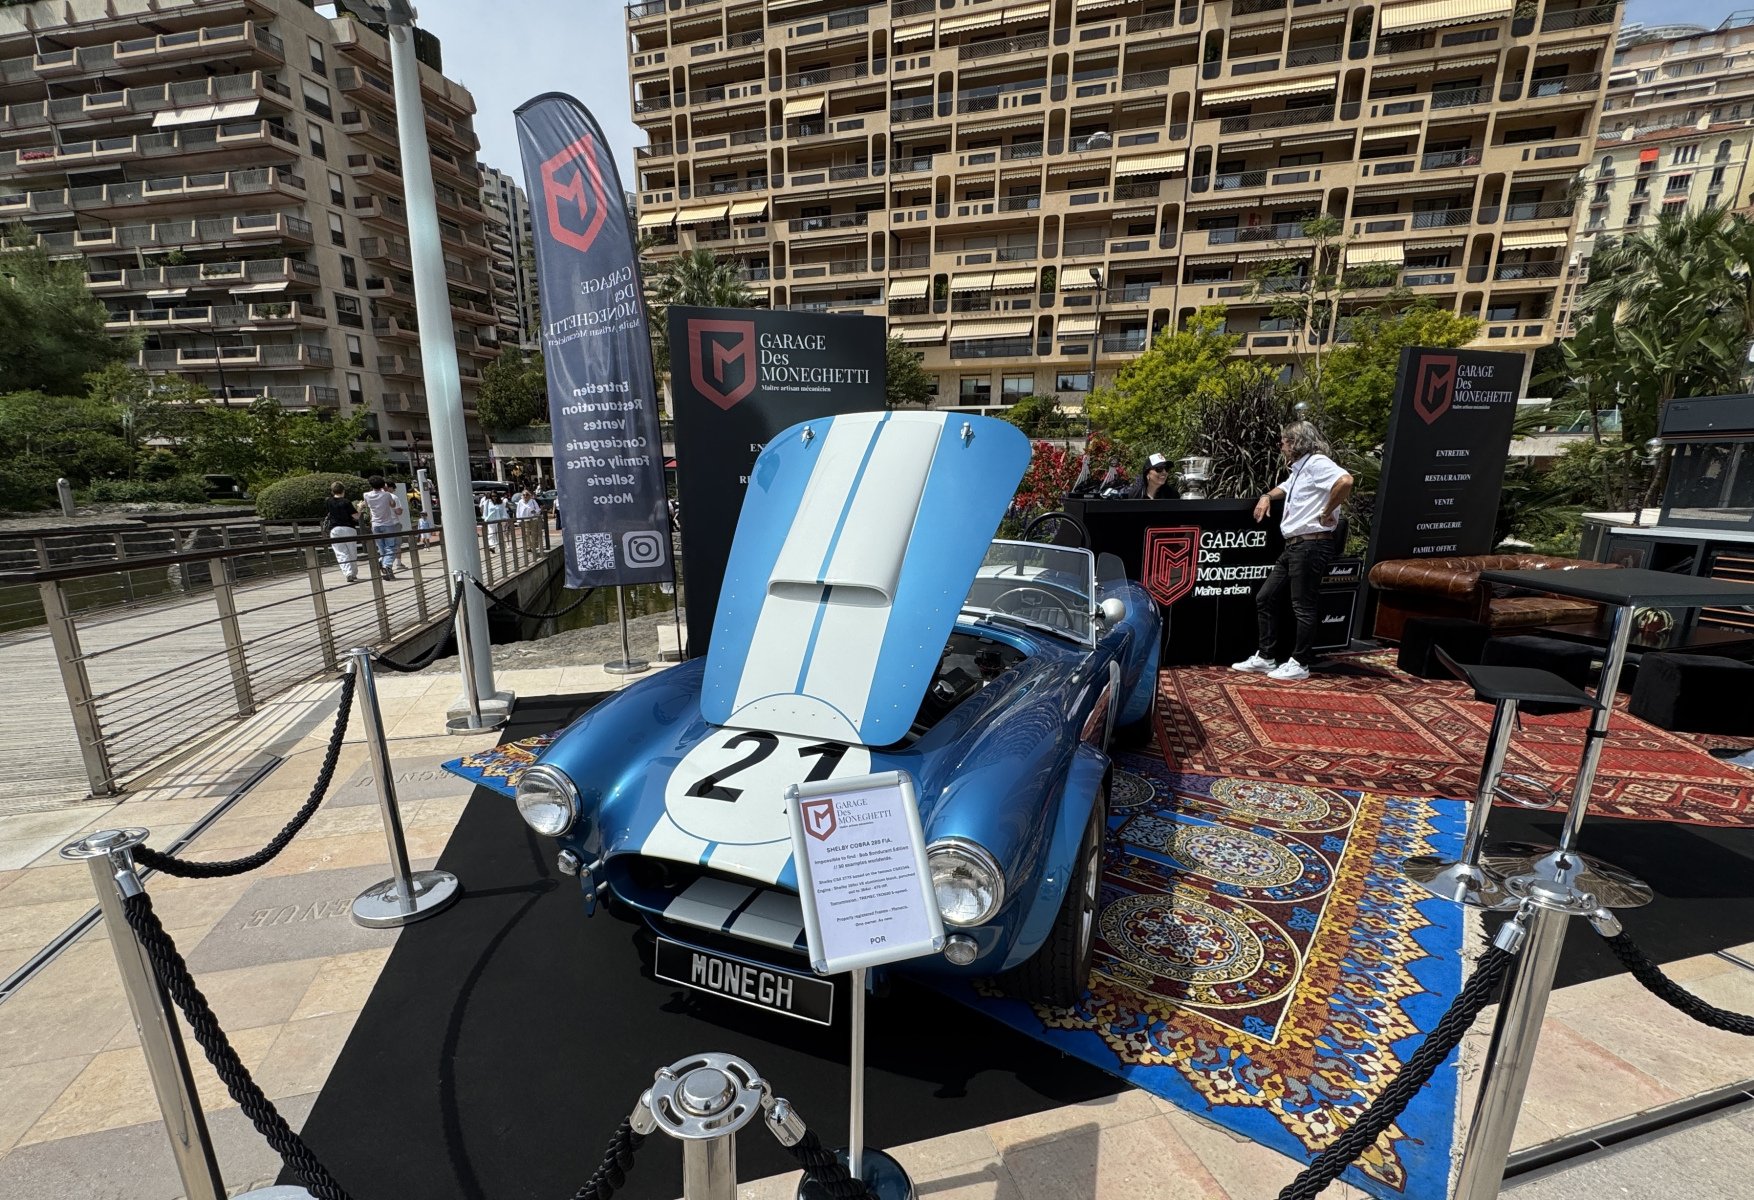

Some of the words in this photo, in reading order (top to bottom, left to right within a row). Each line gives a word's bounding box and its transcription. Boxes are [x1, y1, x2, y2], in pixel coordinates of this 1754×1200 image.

[760, 333, 826, 350] GARAGE
[761, 350, 789, 365] Des
[761, 366, 870, 384] MONEGHETTI
[1457, 364, 1494, 378] GARAGE
[1455, 377, 1472, 390] Des
[1453, 390, 1513, 403] MONEGHETTI
[1436, 449, 1470, 457] ENTRETIEN
[1424, 473, 1472, 482] RESTAURATION
[1434, 498, 1454, 506] VENTE
[1416, 521, 1462, 530] CONCIERGERIE
[1200, 531, 1266, 549] GARAGE
[1412, 545, 1435, 554] FAMILY
[1436, 544, 1457, 553] OFFICE
[1198, 550, 1220, 563] Des
[1195, 586, 1222, 596] Maître
[1223, 583, 1251, 595] artisan
[836, 798, 868, 810] GARAGE
[837, 809, 852, 817] Des
[837, 809, 892, 825] MONEGHETTI
[826, 844, 848, 852] SHELBY
[870, 935, 887, 945] POR
[691, 953, 794, 1010] MONEGH
